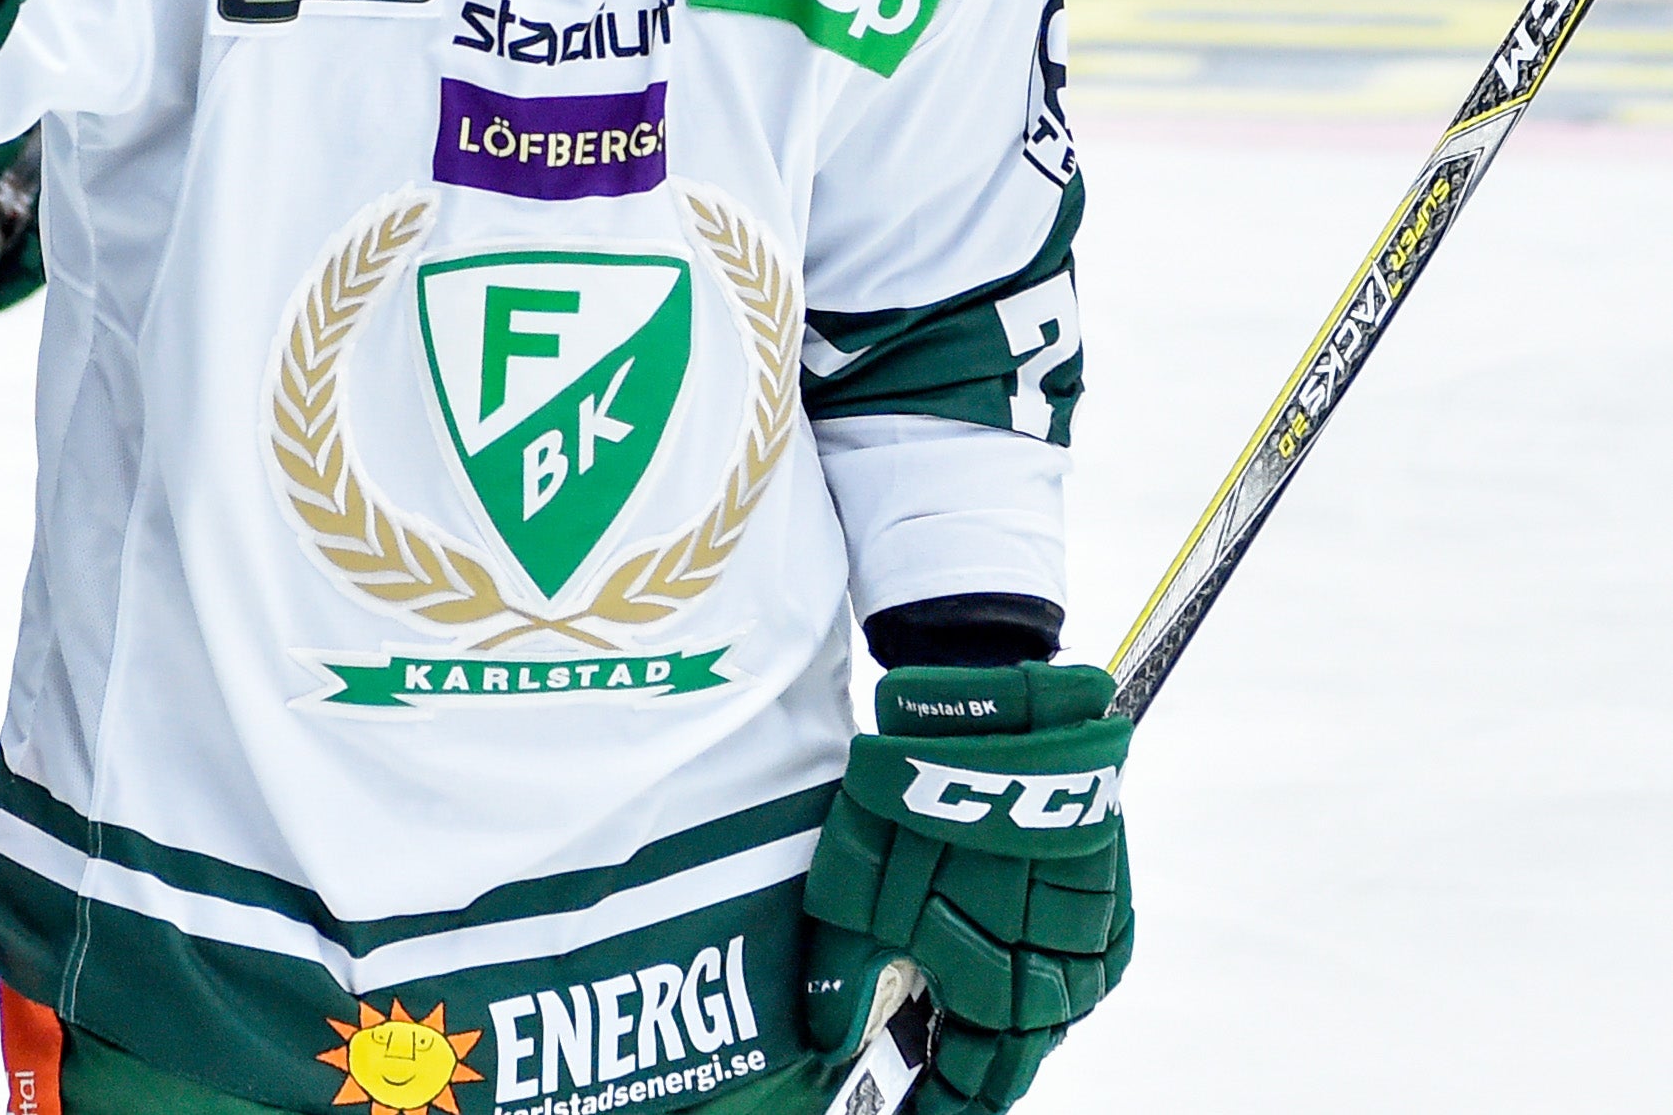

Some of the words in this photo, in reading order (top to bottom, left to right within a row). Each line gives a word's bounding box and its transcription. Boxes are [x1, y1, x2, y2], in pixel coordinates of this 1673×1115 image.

[1390, 178, 1451, 272] SUPER
[1298, 260, 1404, 418] TACKS
[1278, 411, 1309, 459] 2.0
[404, 659, 672, 692] KARLSTAD
[968, 700, 998, 718] BK
[901, 756, 1126, 829] CCM
[488, 934, 759, 1104] ENERGI
